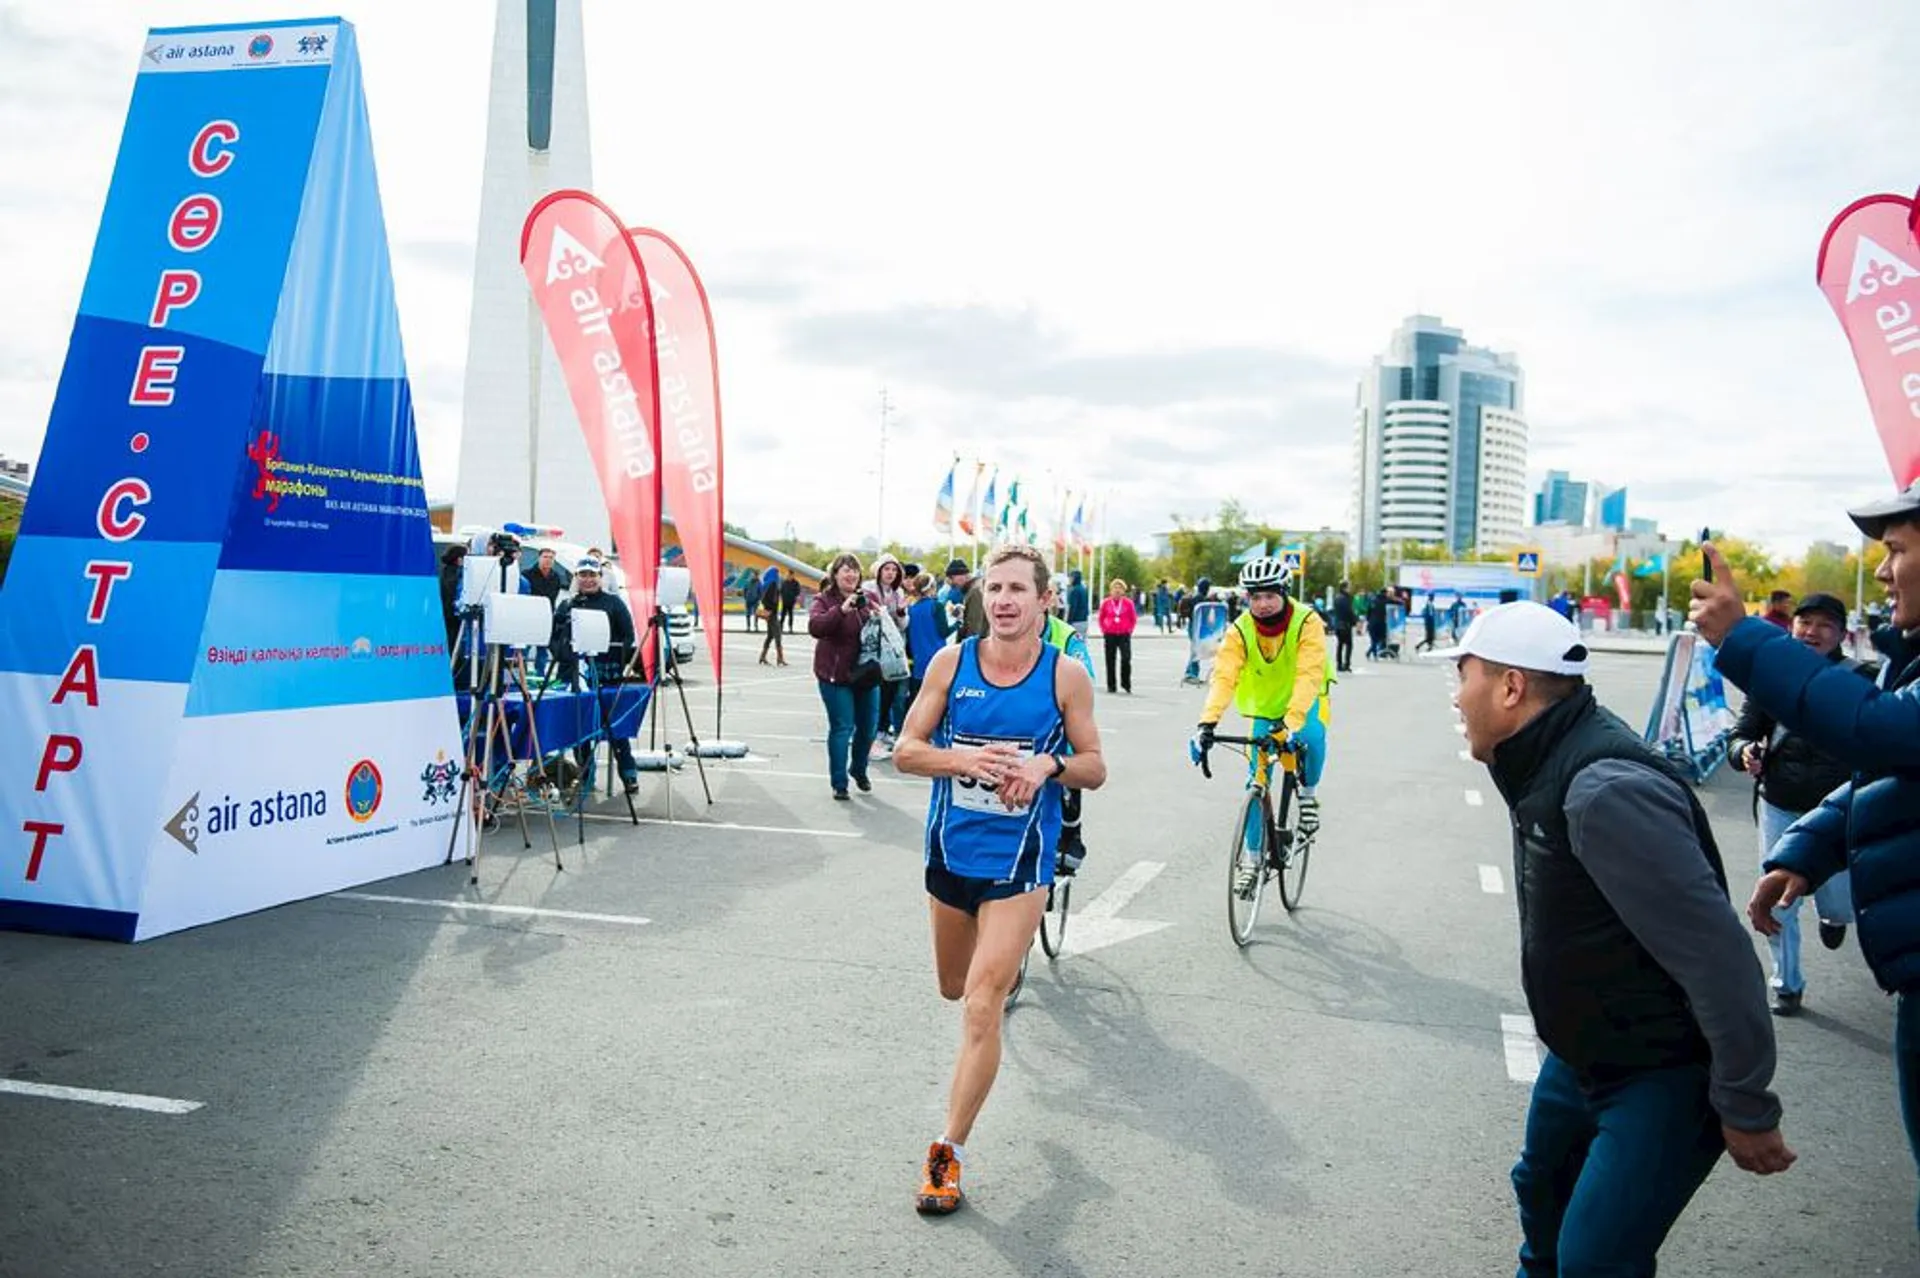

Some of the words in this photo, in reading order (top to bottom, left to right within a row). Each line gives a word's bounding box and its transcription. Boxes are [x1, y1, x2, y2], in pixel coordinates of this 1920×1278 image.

[166, 47, 184, 60] air
[188, 44, 235, 59] astana
[570, 286, 613, 337] air
[592, 349, 655, 480] astana
[662, 376, 718, 493] astana
[265, 479, 328, 498] марафоны
[207, 795, 241, 834] air
[249, 789, 327, 828] astana
